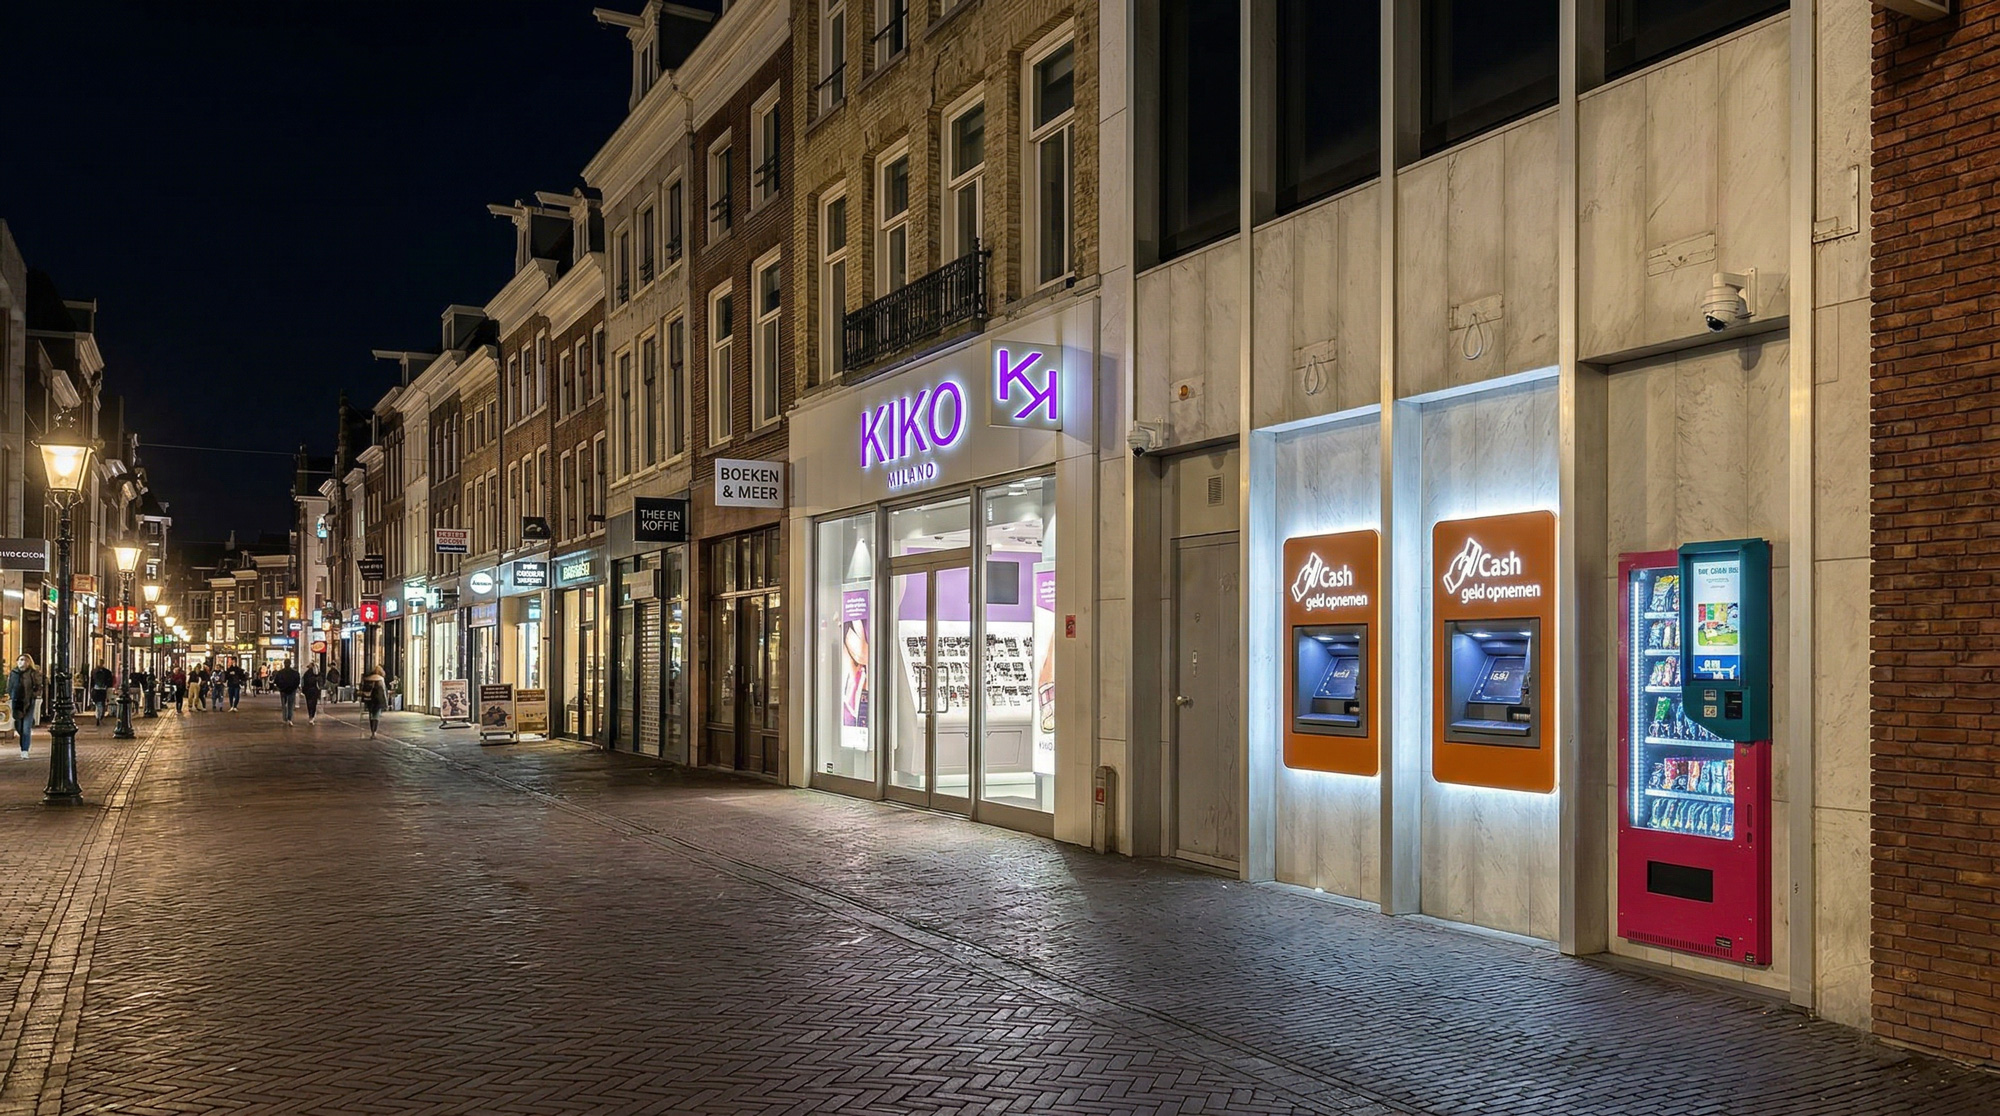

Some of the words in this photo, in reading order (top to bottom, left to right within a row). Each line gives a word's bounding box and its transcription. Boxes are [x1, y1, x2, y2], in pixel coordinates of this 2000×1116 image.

[860, 380, 966, 468] KIKO
[720, 467, 779, 483] BOEKEN
[887, 462, 936, 488] MILANO
[722, 484, 734, 498] &
[738, 485, 778, 500] MEER
[640, 509, 667, 521] THEE
[667, 511, 681, 521] EN
[642, 520, 679, 532] KOFFIE
[1478, 550, 1522, 578] Cash
[1319, 564, 1353, 588] Cash
[1305, 592, 1325, 611] geld
[1326, 594, 1368, 610] opnemen
[1461, 582, 1485, 604] geld
[1486, 583, 1541, 602] opnemen
